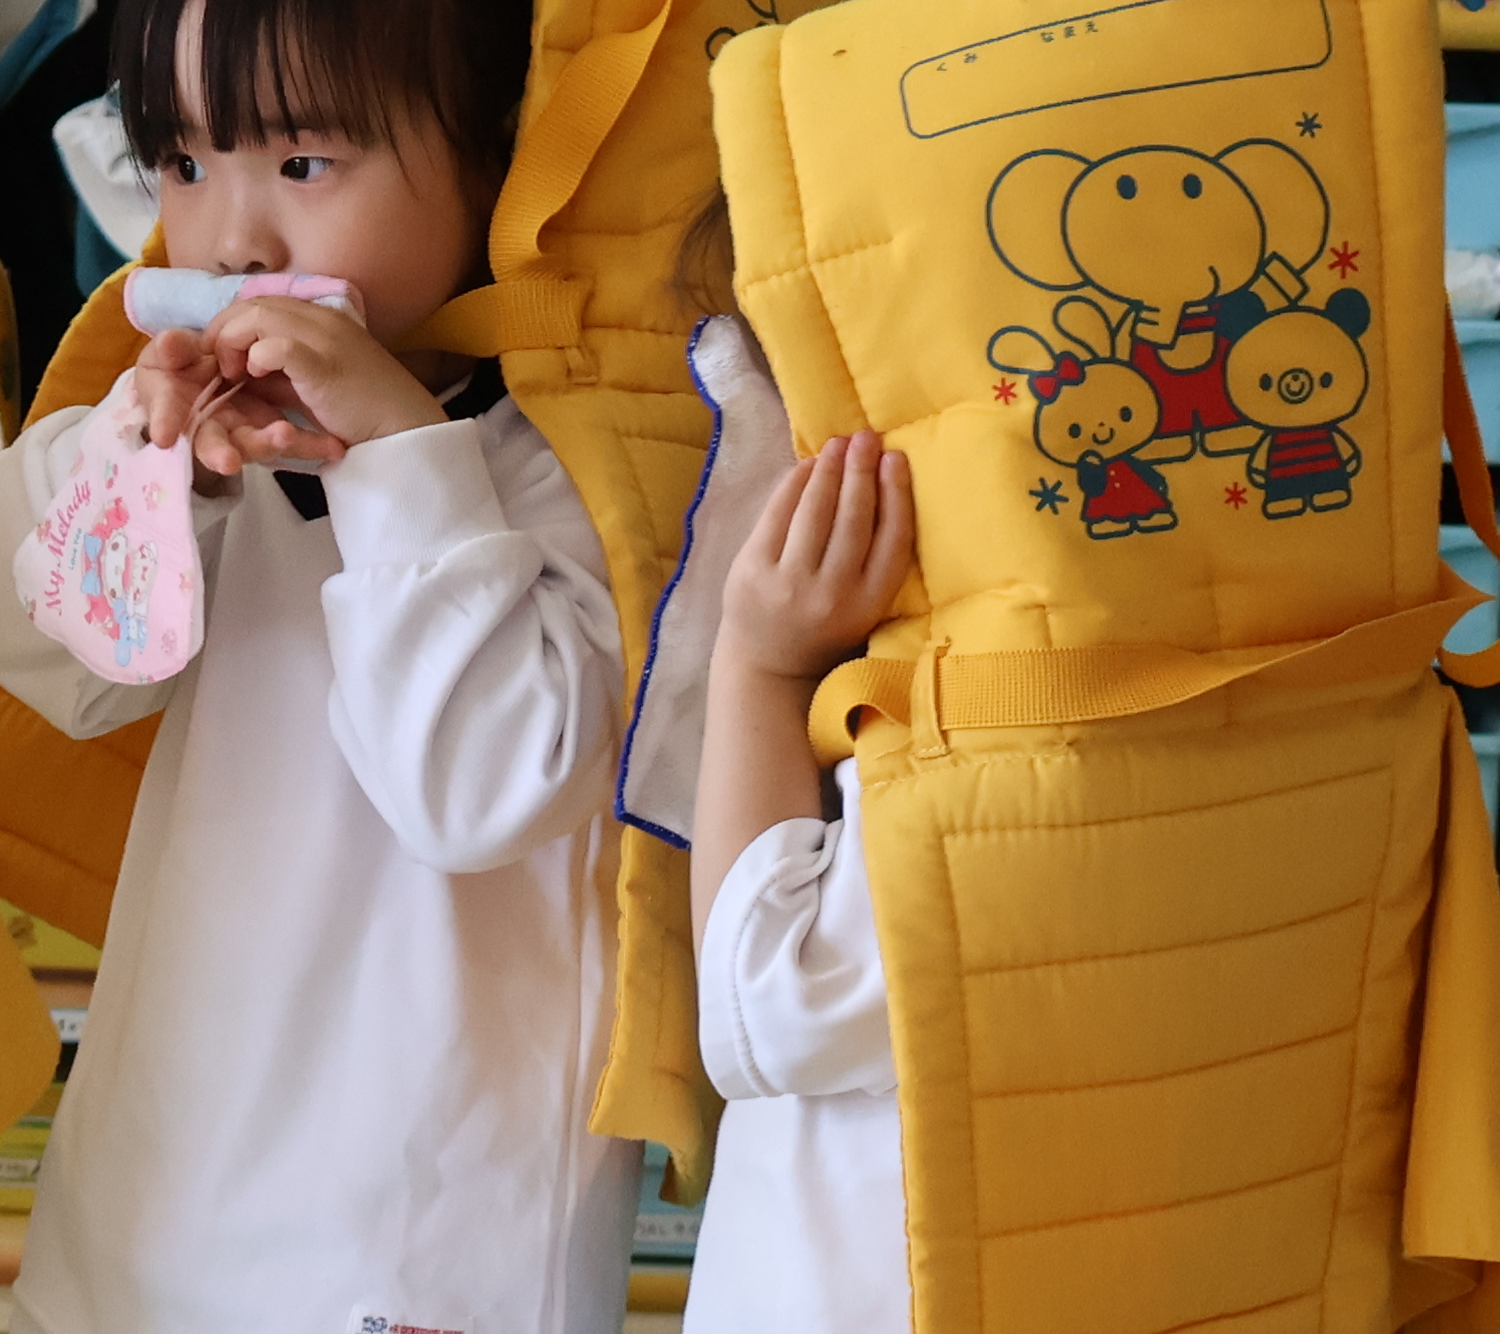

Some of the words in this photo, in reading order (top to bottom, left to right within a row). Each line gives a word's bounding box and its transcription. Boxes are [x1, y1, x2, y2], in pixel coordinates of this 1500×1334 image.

[1040, 20, 1099, 43] なまえ
[47, 479, 92, 569] Melody
[43, 569, 66, 617] My
